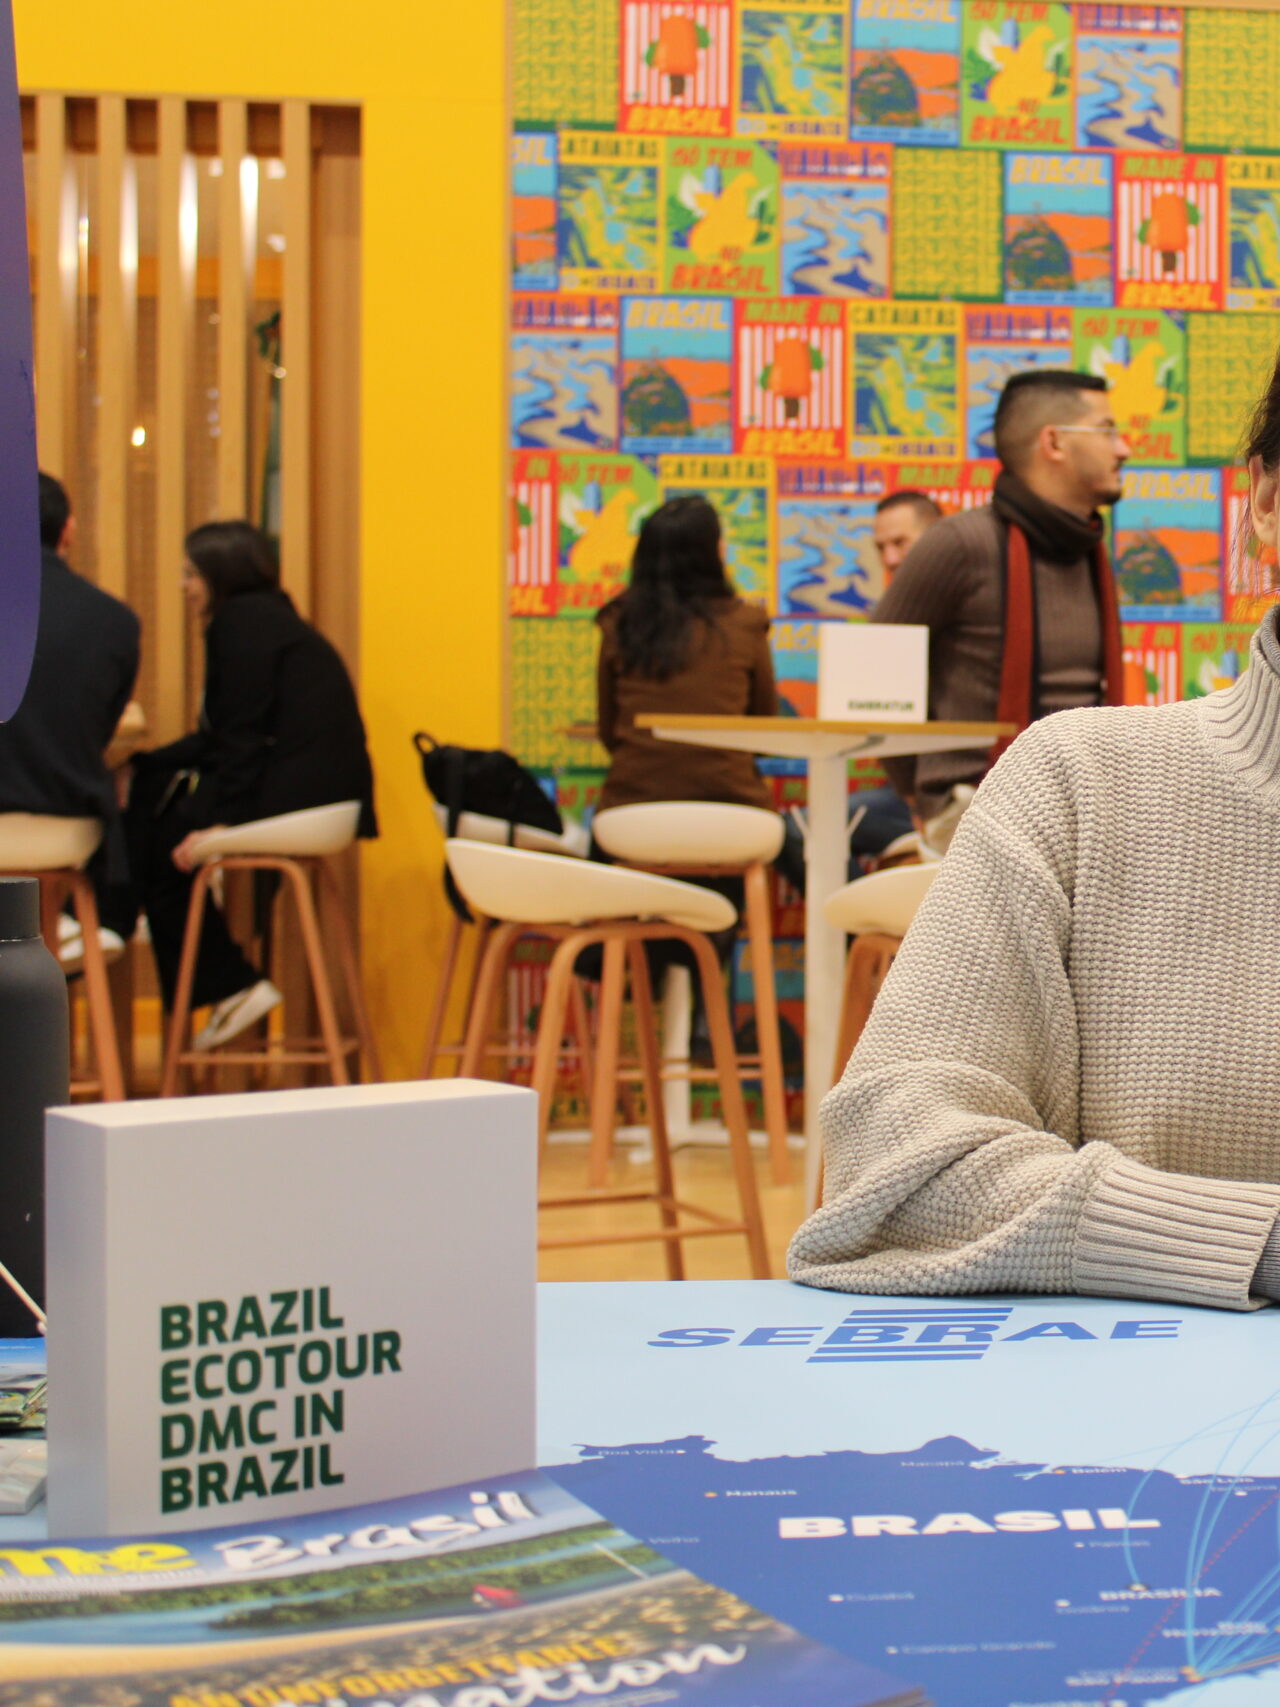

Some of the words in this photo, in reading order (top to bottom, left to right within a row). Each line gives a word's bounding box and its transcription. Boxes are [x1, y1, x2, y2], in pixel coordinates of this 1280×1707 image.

[626, 106, 727, 133] BRASIL
[970, 115, 1068, 143] BRASIL
[706, 147, 754, 169] TEM
[1009, 156, 1108, 185] BRASIL
[1123, 157, 1187, 178] MADE
[670, 264, 771, 292] BRASIL
[1121, 283, 1218, 309] BRASIL
[626, 300, 729, 330] BRASIL
[743, 302, 808, 323] MADE
[1115, 318, 1161, 339] TEM
[742, 430, 842, 456] BRASIL
[897, 466, 962, 488] MADE
[1123, 472, 1217, 501] BRASIL
[160, 1285, 344, 1351] BRAZIL
[648, 1321, 1183, 1347] SEBRAE
[160, 1329, 402, 1406] ECOTOUR
[160, 1398, 277, 1459] DMC
[295, 1389, 345, 1439] IN
[160, 1443, 345, 1515] BRAZIL
[726, 1488, 798, 1497] Manaus
[217, 1490, 540, 1571] Brasil
[779, 1509, 1160, 1539] BRASIL
